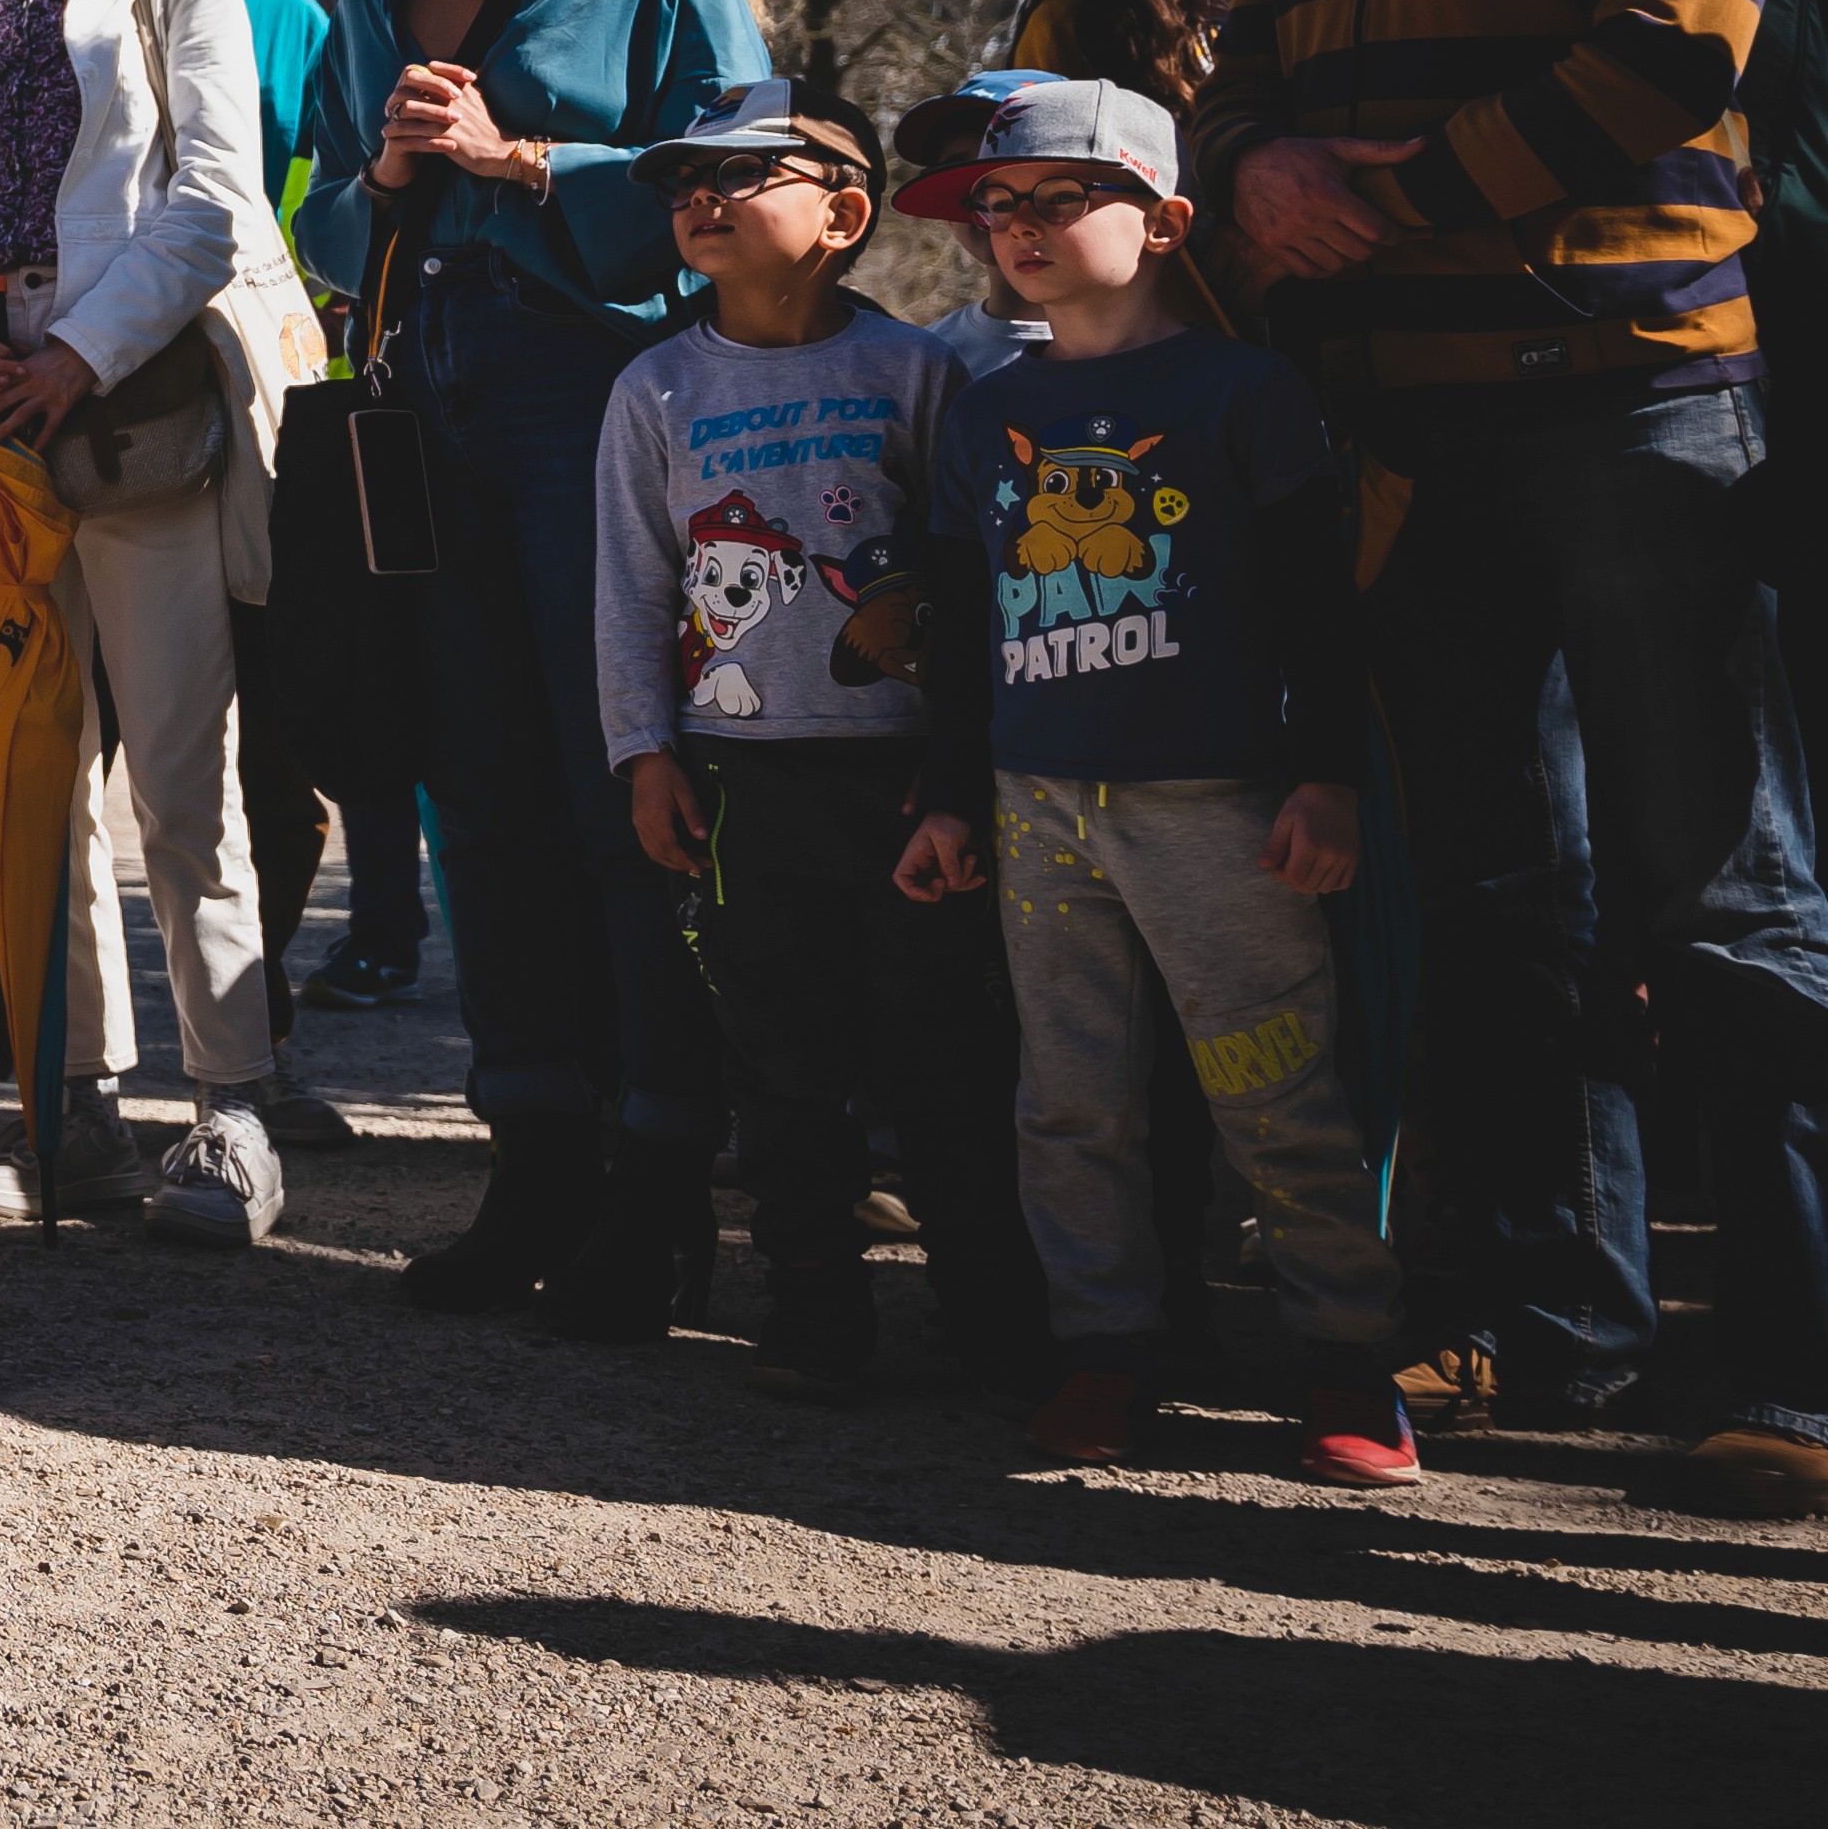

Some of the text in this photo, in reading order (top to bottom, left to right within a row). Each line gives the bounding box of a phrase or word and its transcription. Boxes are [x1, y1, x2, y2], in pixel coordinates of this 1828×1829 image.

[689, 396, 905, 450] DEBOUT POUR
[998, 533, 1172, 639] PAW
[1001, 610, 1180, 685] PATROL
[1187, 1010, 1320, 1096] ARVEL
